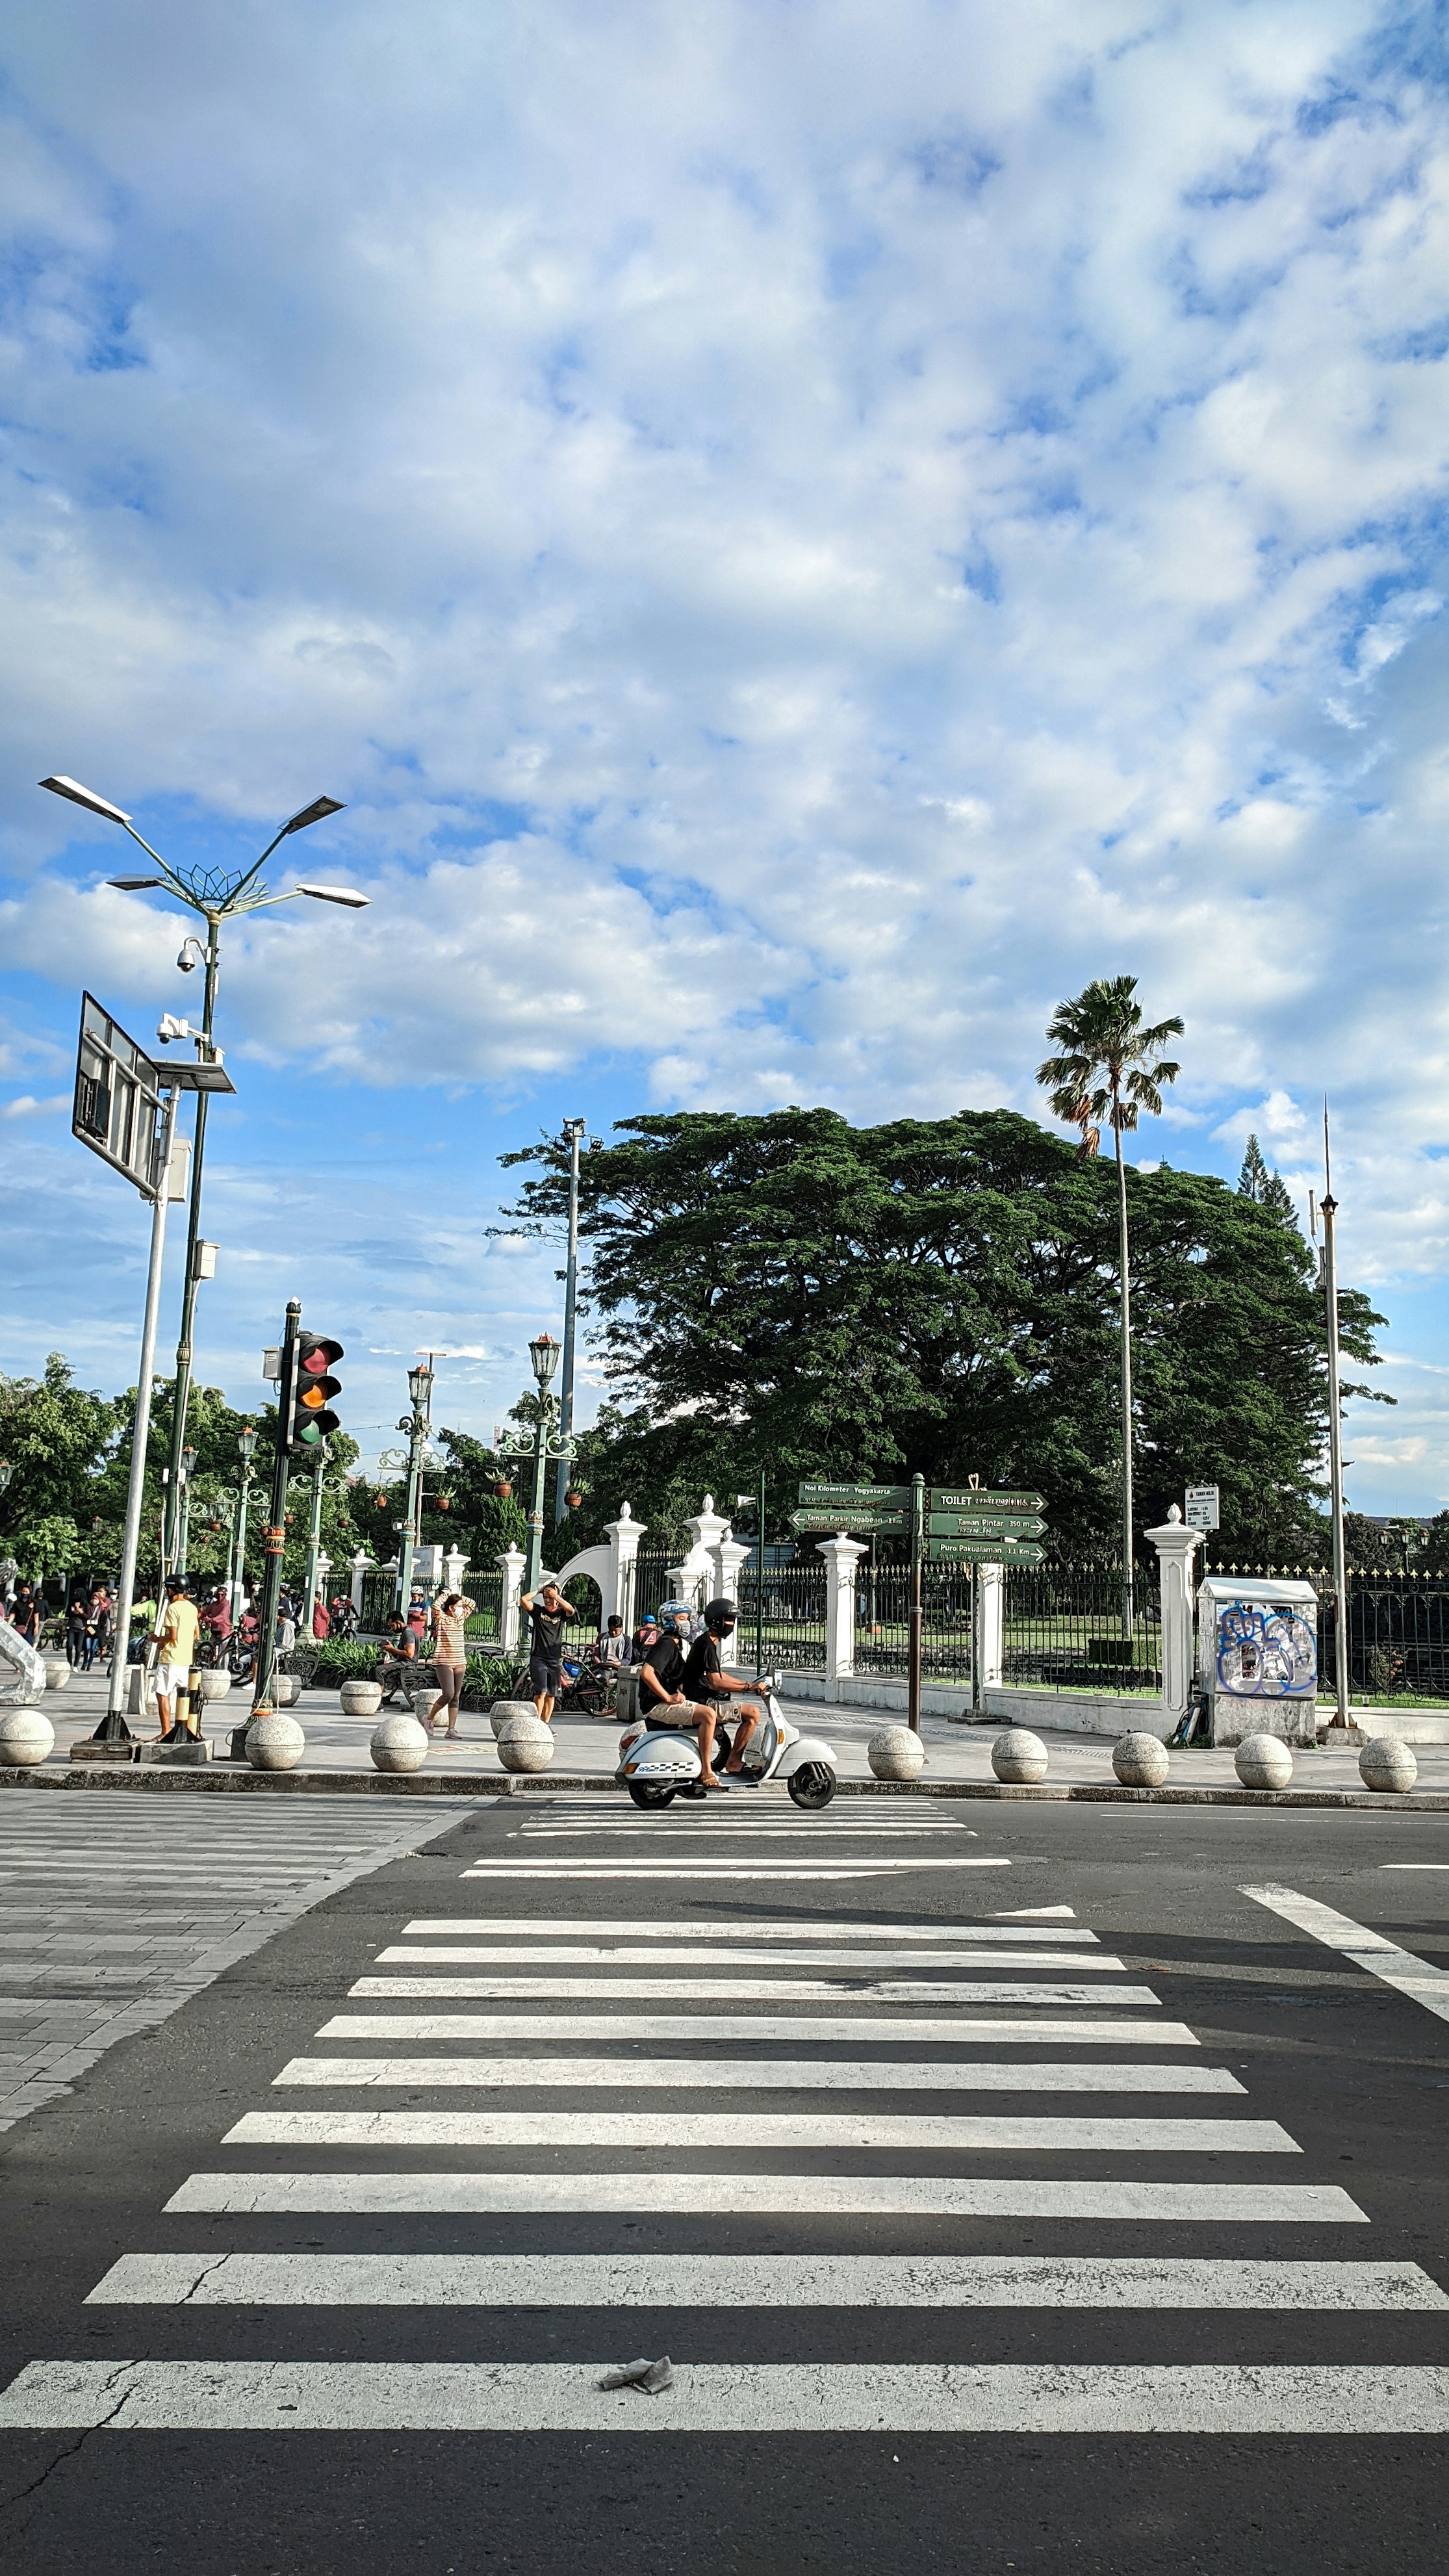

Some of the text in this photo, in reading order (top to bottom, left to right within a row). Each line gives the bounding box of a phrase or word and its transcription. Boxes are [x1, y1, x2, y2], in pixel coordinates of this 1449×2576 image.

[941, 1495, 972, 1506] TOILET
[851, 1515, 883, 1524] Ngabean
[959, 1545, 1002, 1554] Pakualaman
